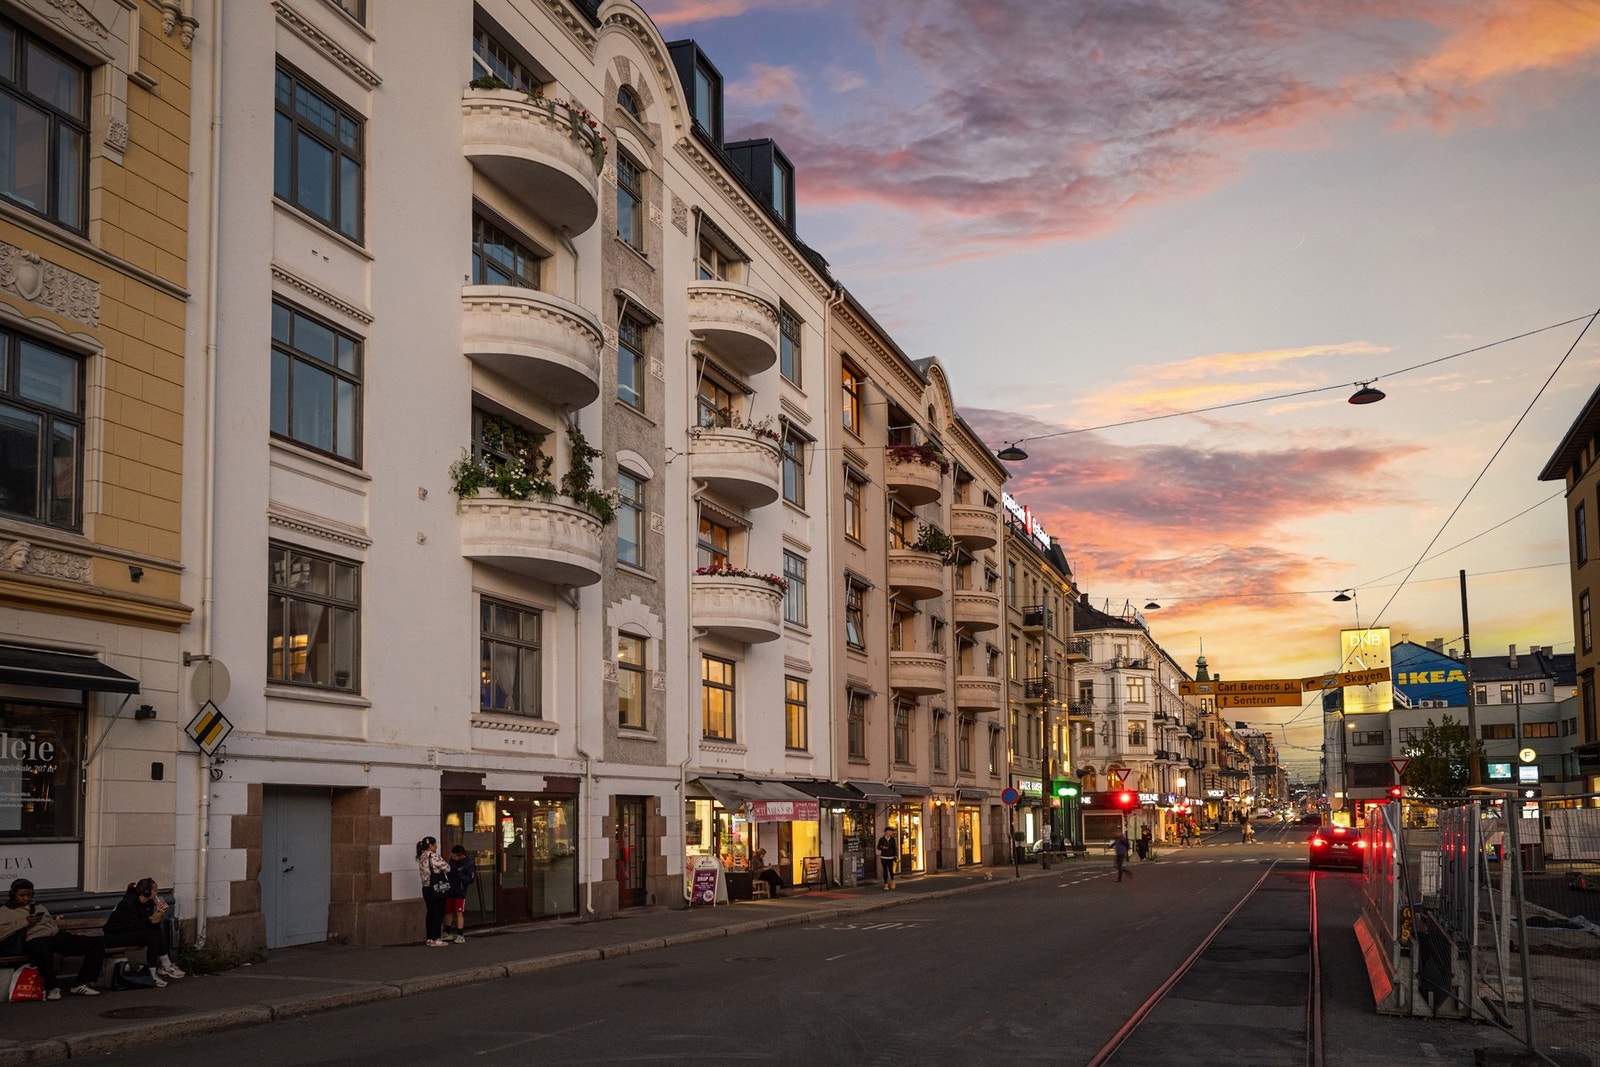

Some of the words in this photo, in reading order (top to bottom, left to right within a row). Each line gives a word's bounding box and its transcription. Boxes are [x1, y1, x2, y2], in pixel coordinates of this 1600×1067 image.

[1350, 633, 1381, 648] DNB
[1344, 672, 1383, 683] Skøyen
[1398, 669, 1467, 685] IKEA
[1217, 683, 1237, 692] Carl
[1240, 682, 1280, 690] Berners
[1233, 697, 1276, 705] Sentrum
[0, 732, 54, 762] leie
[0, 857, 33, 869] EVA
